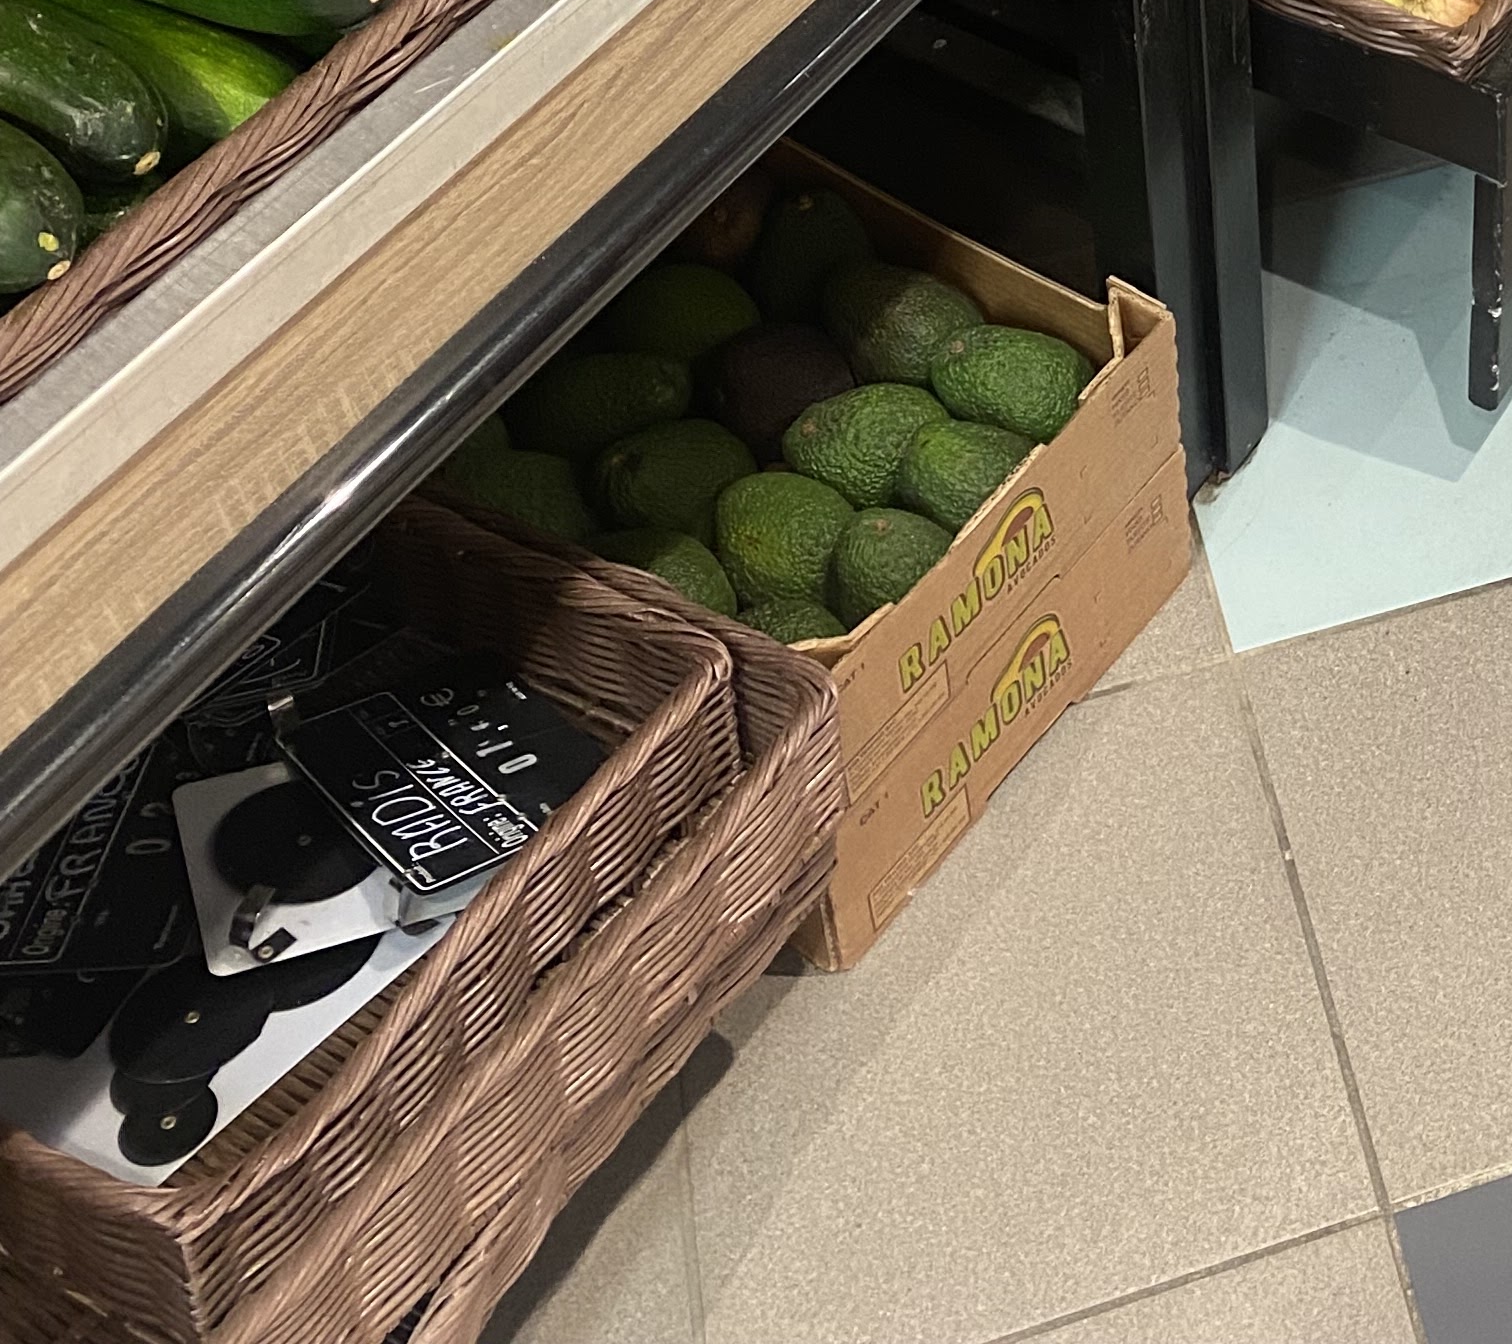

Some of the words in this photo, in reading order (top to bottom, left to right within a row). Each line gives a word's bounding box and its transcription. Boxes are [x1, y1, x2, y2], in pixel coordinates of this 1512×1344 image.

[898, 502, 1055, 694] RAMONA
[1006, 535, 1058, 595] AVOCADOS
[920, 628, 1071, 819] RAMONA
[1022, 660, 1074, 718] AVOCADOS
[350, 770, 469, 862] RADIS
[405, 758, 506, 816] FRANCE
